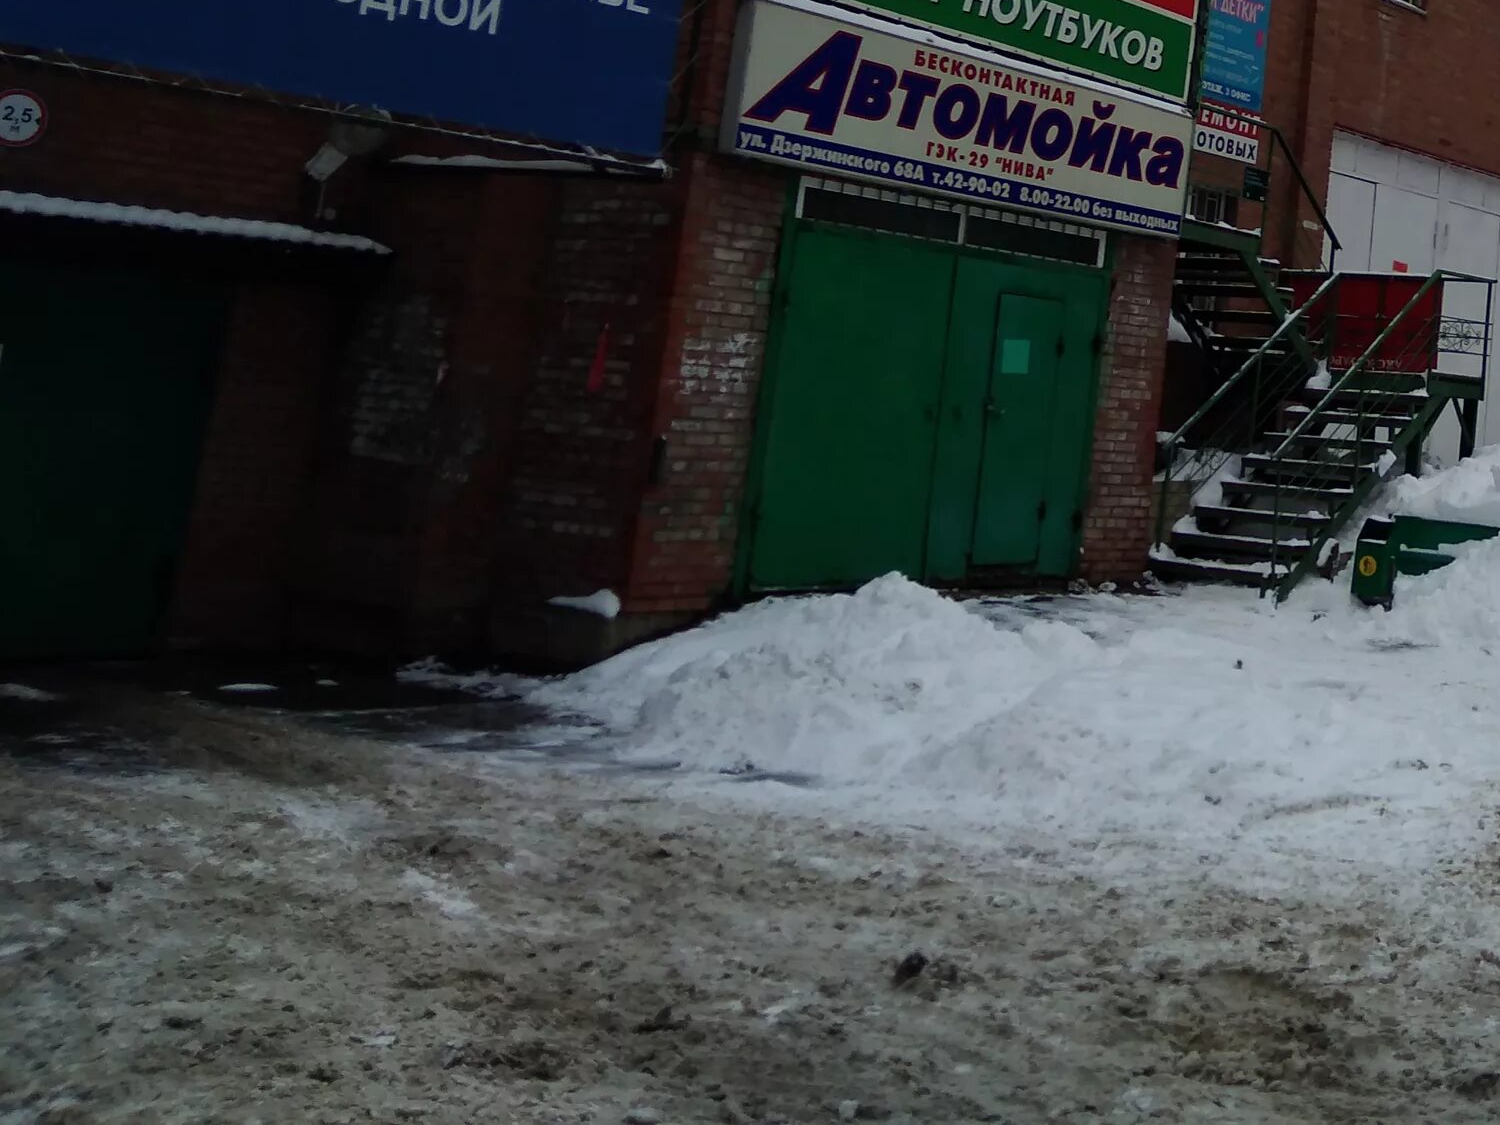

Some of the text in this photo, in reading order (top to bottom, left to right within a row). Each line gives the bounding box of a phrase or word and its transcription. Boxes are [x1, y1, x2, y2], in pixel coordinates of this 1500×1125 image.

[915, 49, 1075, 106] БЕСКОНТАКТНАЯ
[2, 105, 33, 125] 2,5
[1200, 102, 1260, 135] ЕМОНТ
[1197, 131, 1256, 160] ОТОВЫХ
[740, 131, 1178, 231] ул. Дзержинского 68А т.42-90-02 8.00-22.00 без выходных
